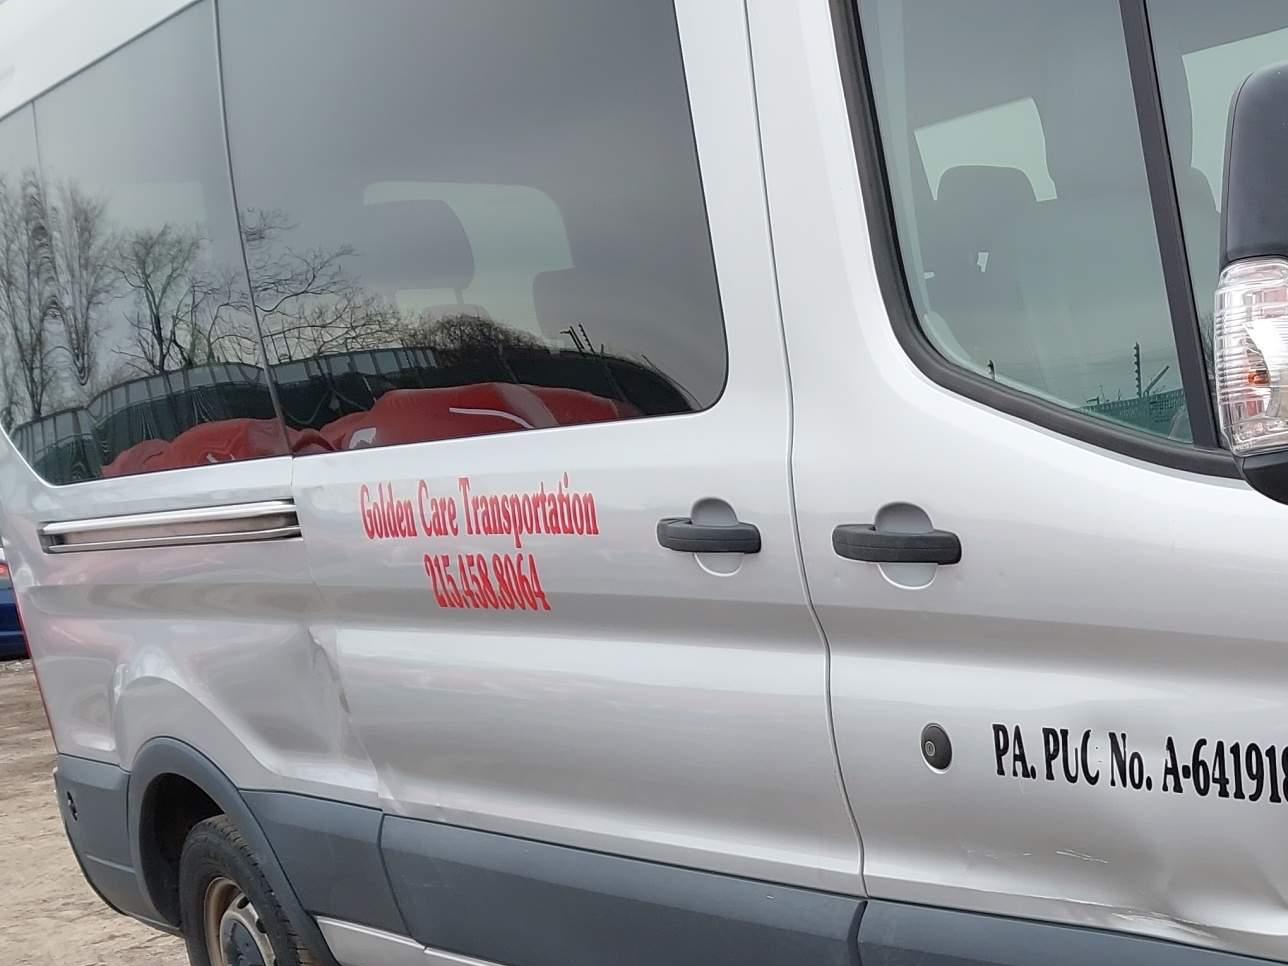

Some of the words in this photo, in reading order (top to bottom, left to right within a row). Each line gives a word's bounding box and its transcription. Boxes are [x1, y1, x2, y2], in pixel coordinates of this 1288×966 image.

[360, 482, 418, 540] Golden
[417, 479, 459, 537] Care
[458, 471, 600, 549] Transportation
[423, 552, 552, 611] 215.458.8064
[992, 723, 1037, 780] PA.
[1042, 727, 1100, 786] PUC
[1108, 731, 1153, 792] No.
